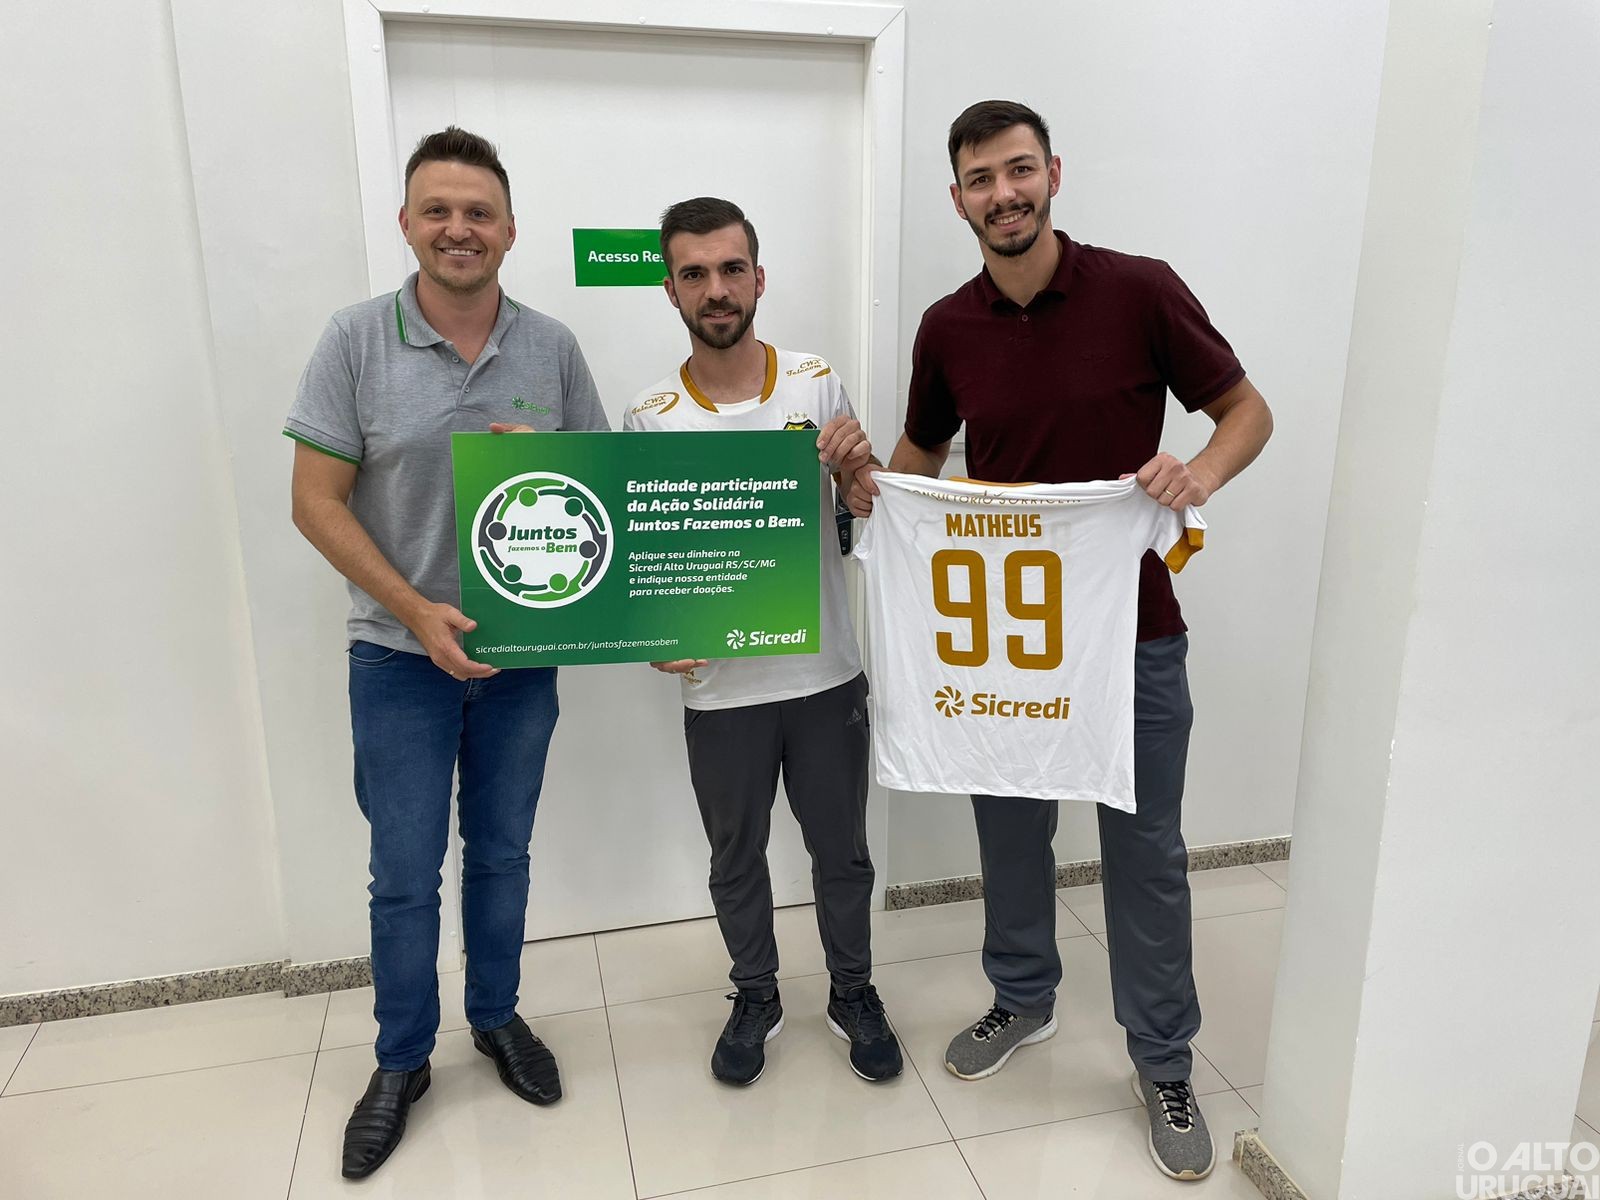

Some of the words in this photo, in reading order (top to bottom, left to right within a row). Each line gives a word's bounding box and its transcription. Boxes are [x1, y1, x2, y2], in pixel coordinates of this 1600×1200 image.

[588, 250, 639, 262] Acesso
[626, 479, 698, 493] Entidade
[700, 477, 799, 494] participante
[627, 500, 647, 512] da
[650, 498, 690, 514] Ação
[693, 497, 764, 511] Solidária
[627, 519, 680, 532] Juntos
[683, 517, 751, 531] Fazemos
[755, 518, 765, 528] o
[768, 515, 805, 528] Bem.
[945, 513, 1042, 538] MATHEUS
[507, 525, 577, 541] Juntos
[546, 542, 577, 553] Bem
[628, 551, 666, 561] Aplique
[687, 550, 727, 559] dinheiro
[629, 562, 662, 572] Sicredi
[664, 561, 684, 571] Alto
[686, 560, 724, 573] Uruguai
[726, 559, 776, 569] RS/SC/MG
[637, 575, 673, 586] indique
[675, 575, 704, 583] nossa
[706, 572, 748, 582] entidade
[629, 588, 652, 598] para
[654, 585, 692, 595] receber
[693, 584, 735, 595] doações.
[931, 548, 1064, 671] 99
[749, 629, 807, 646] Sicredi
[475, 638, 679, 654] sicredialtouruguai.com.br/juntosfazemosobem
[971, 692, 1071, 720] Sicredi
